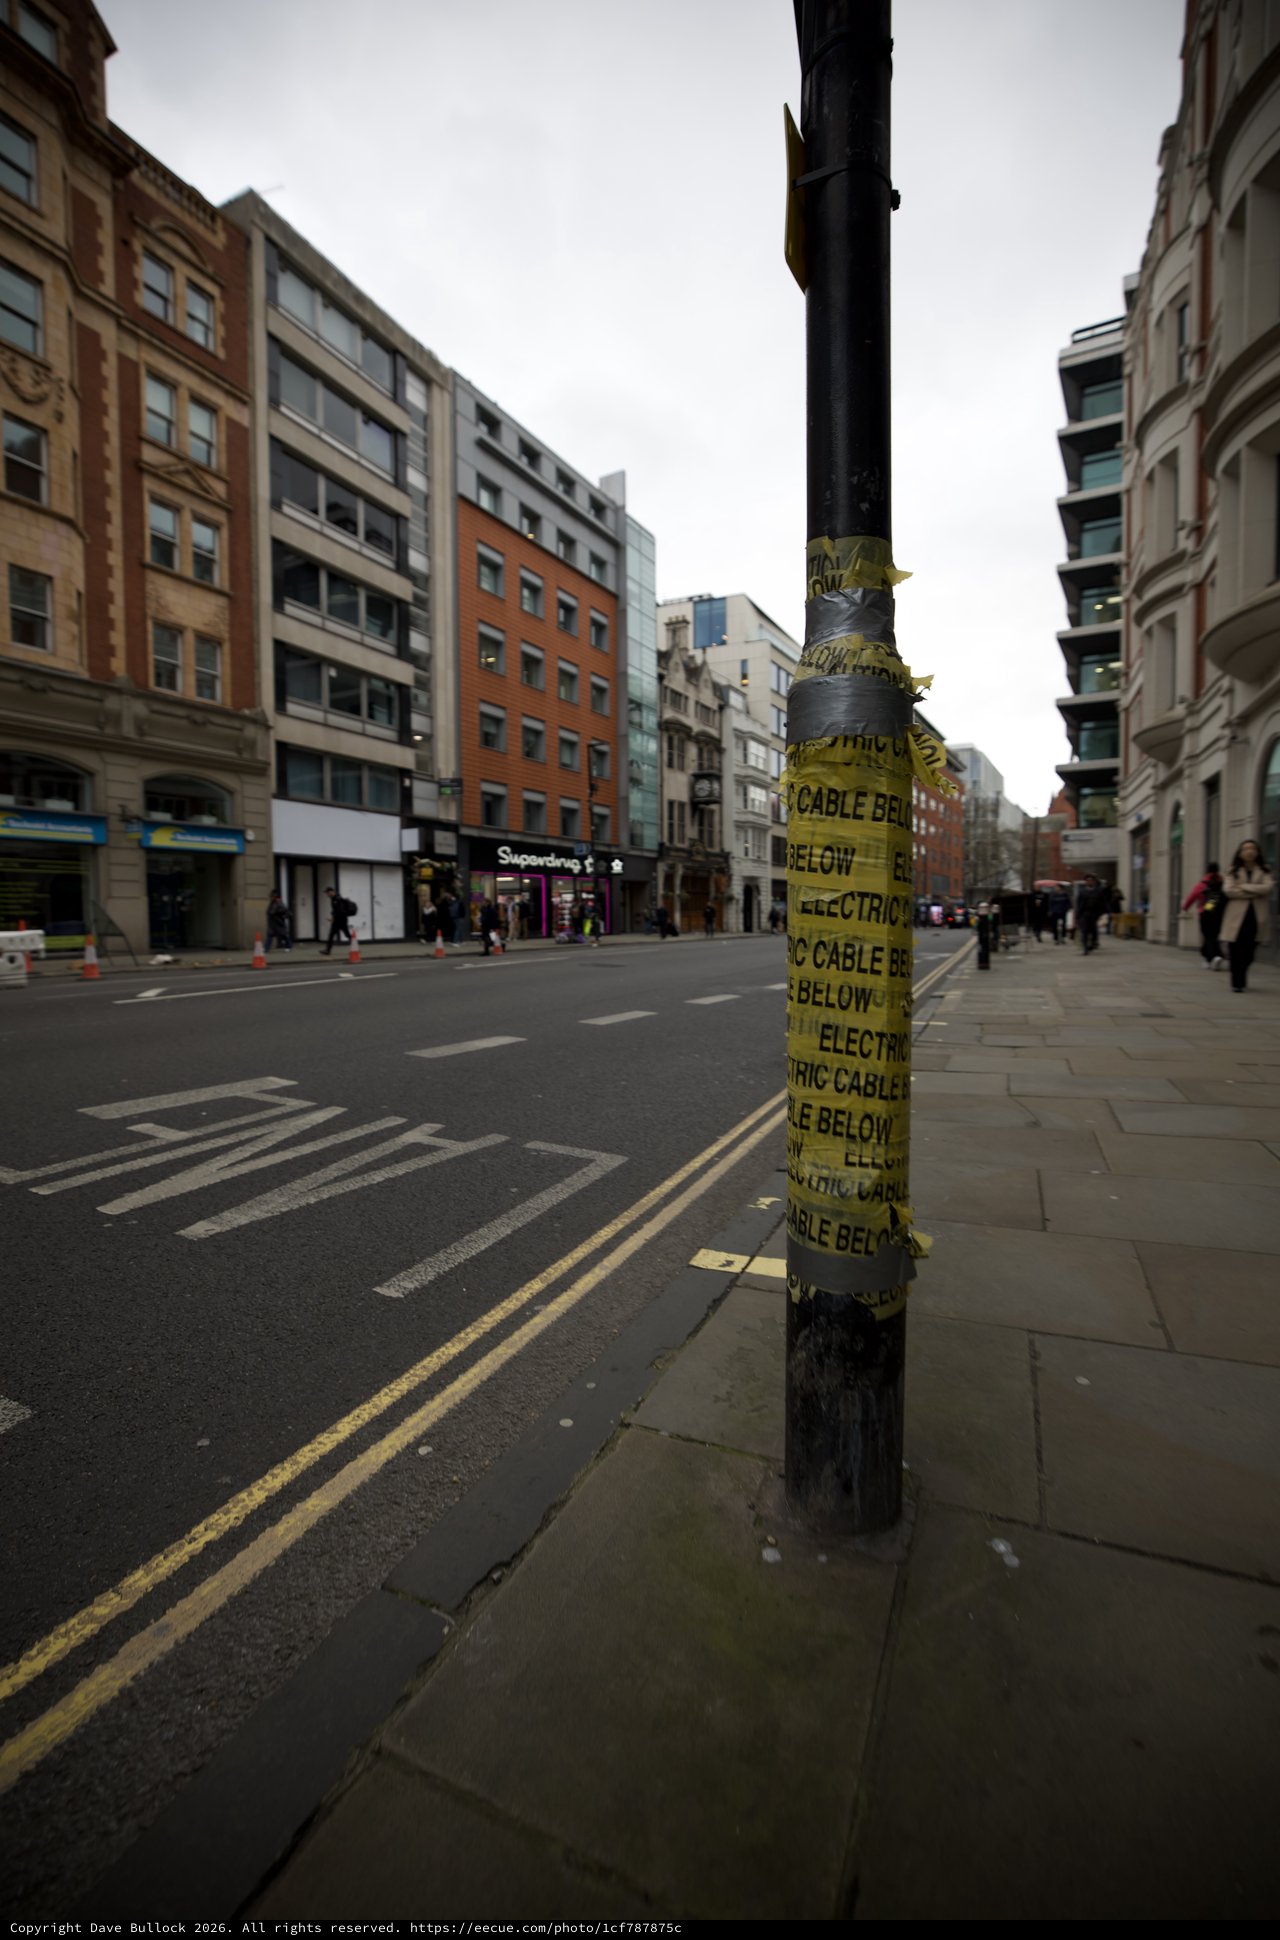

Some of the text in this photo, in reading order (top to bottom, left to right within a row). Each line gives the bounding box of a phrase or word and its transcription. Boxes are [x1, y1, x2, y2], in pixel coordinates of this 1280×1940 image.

[797, 784, 868, 821] CABLE
[497, 846, 581, 874] Superdrug
[789, 843, 856, 877] BELOW
[801, 891, 900, 926] ELECTRIC
[812, 939, 884, 976] CABLE
[797, 979, 873, 1014] BELOW
[819, 1024, 909, 1062] ELECTRIC
[833, 1067, 899, 1101] CABLE
[817, 1106, 894, 1146] BELOW
